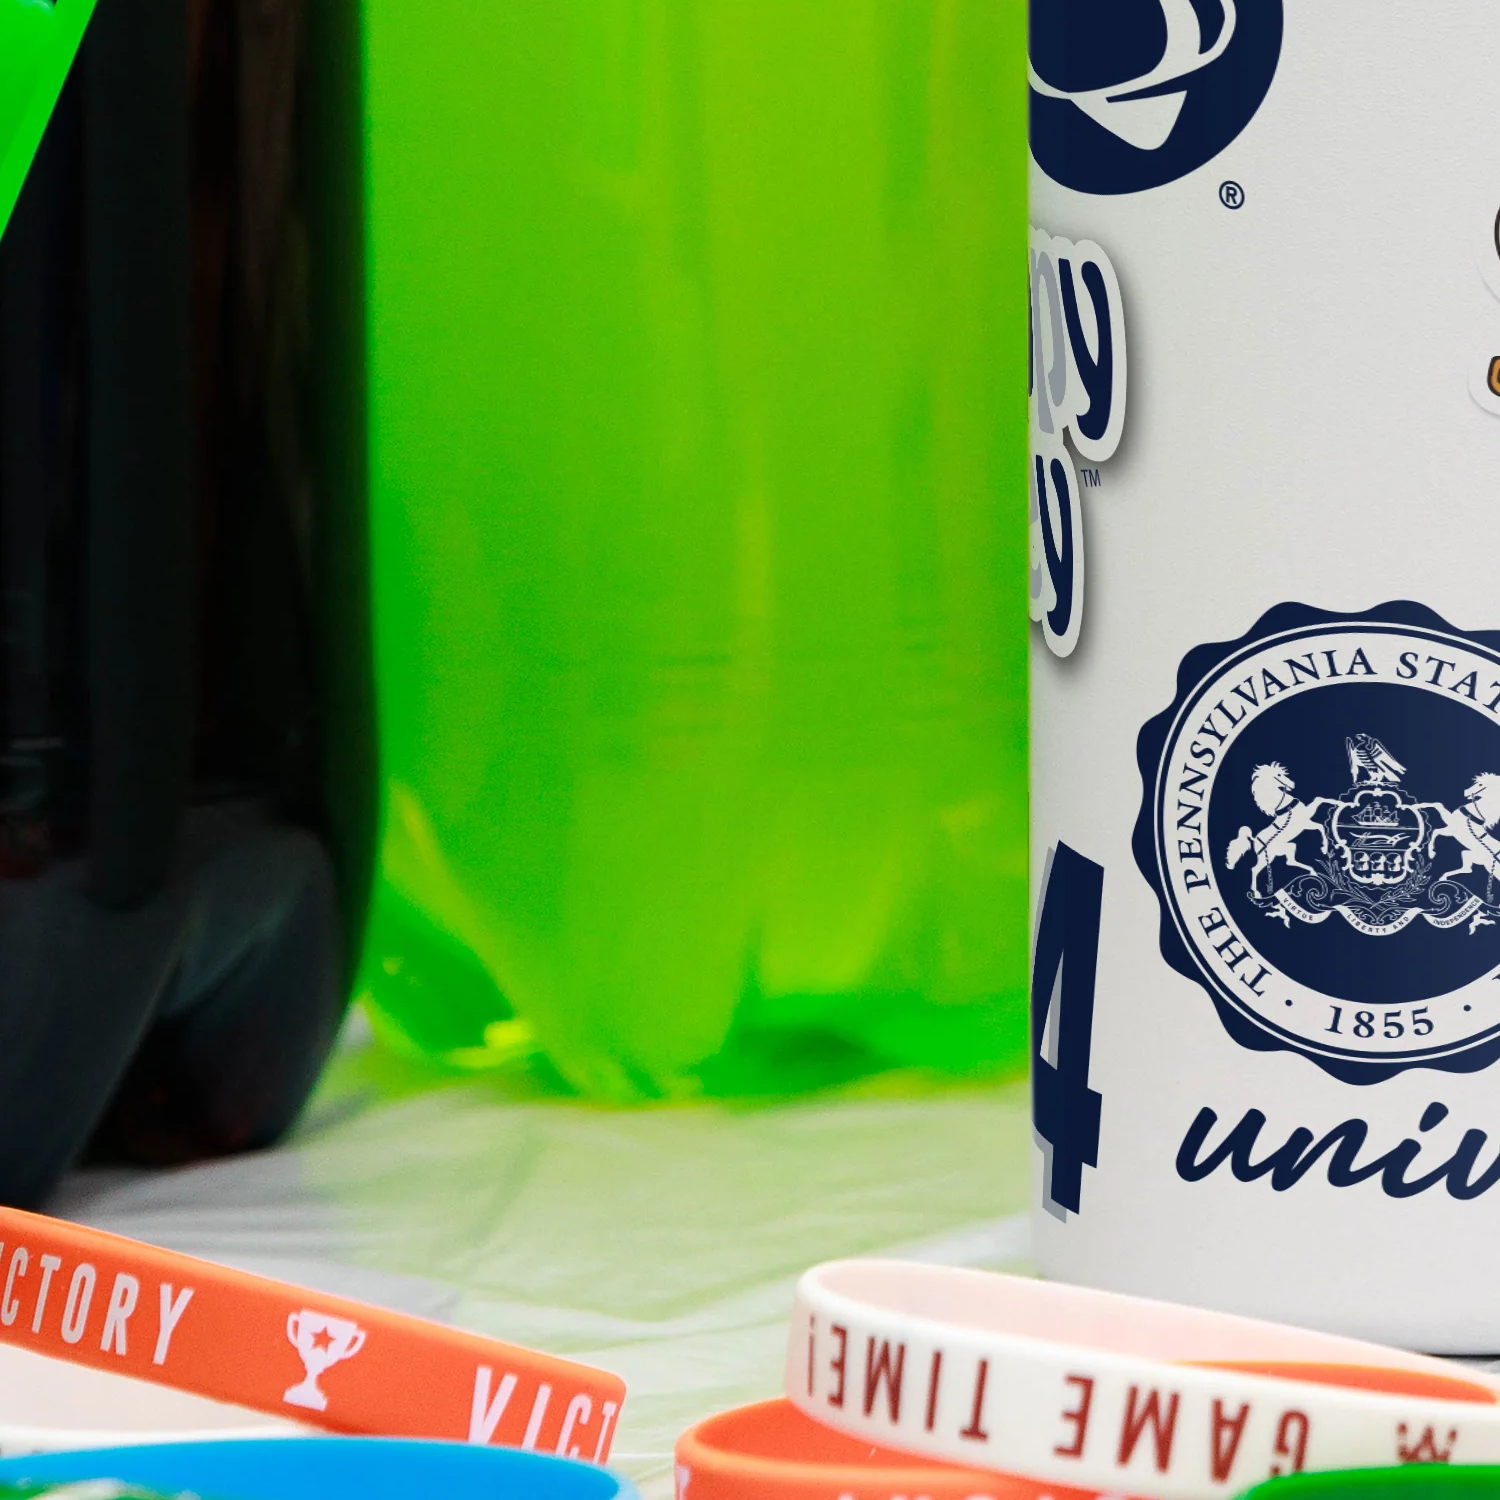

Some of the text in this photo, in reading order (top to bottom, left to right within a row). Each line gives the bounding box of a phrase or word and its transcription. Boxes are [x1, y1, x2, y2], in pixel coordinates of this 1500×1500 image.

[1028, 248, 1113, 440] py
[1177, 647, 1377, 893] PENNSYLVANIA
[1198, 906, 1272, 997] THE
[1325, 1004, 1434, 1041] 1855
[0, 1238, 195, 1367] CTORY
[806, 1314, 1311, 1483] GAME TIME!
